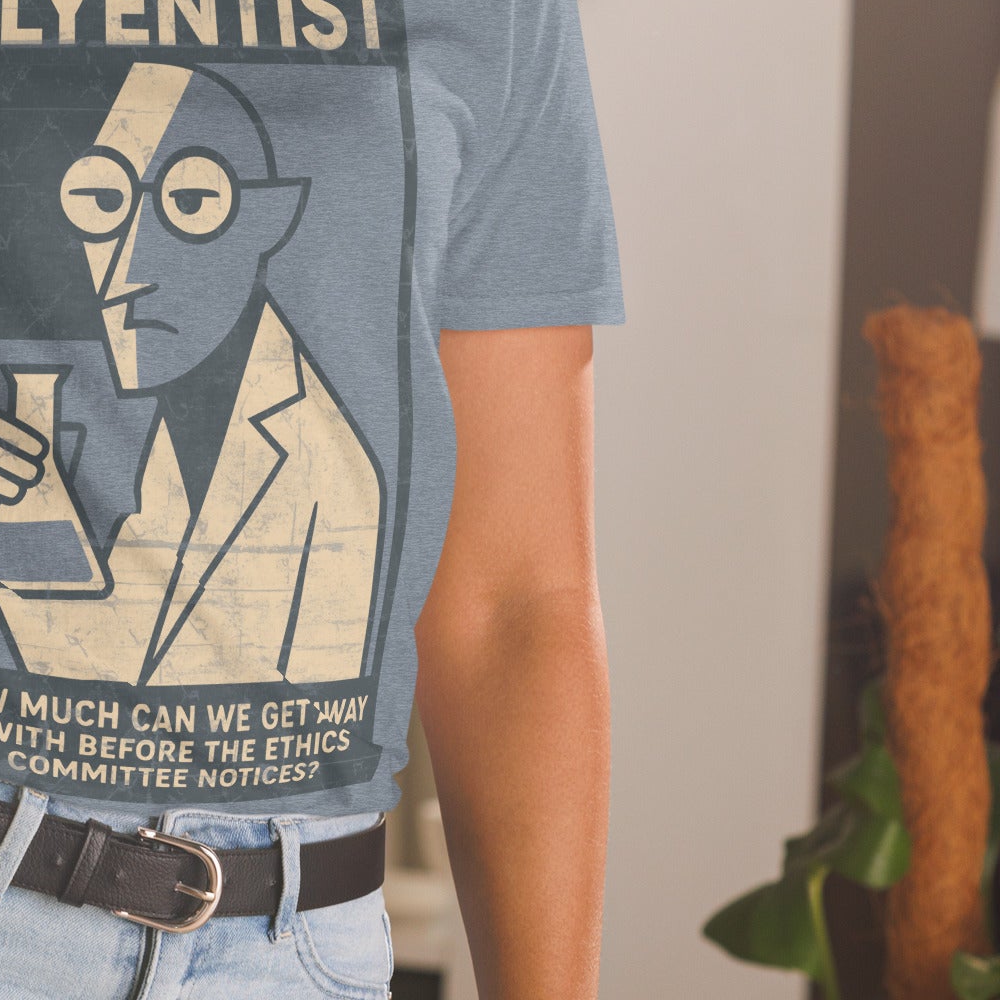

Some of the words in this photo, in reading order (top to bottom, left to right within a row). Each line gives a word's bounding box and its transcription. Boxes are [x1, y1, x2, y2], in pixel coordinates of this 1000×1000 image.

[20, 691, 119, 729] MUCH
[131, 703, 196, 733] CAN
[207, 703, 251, 733] WE
[261, 698, 310, 730] GET
[78, 733, 194, 763] BEFORE
[204, 738, 256, 763] THE
[265, 729, 351, 761] ETHICS
[7, 750, 189, 788] COMMITTEE
[198, 760, 320, 788] NOTICES?
